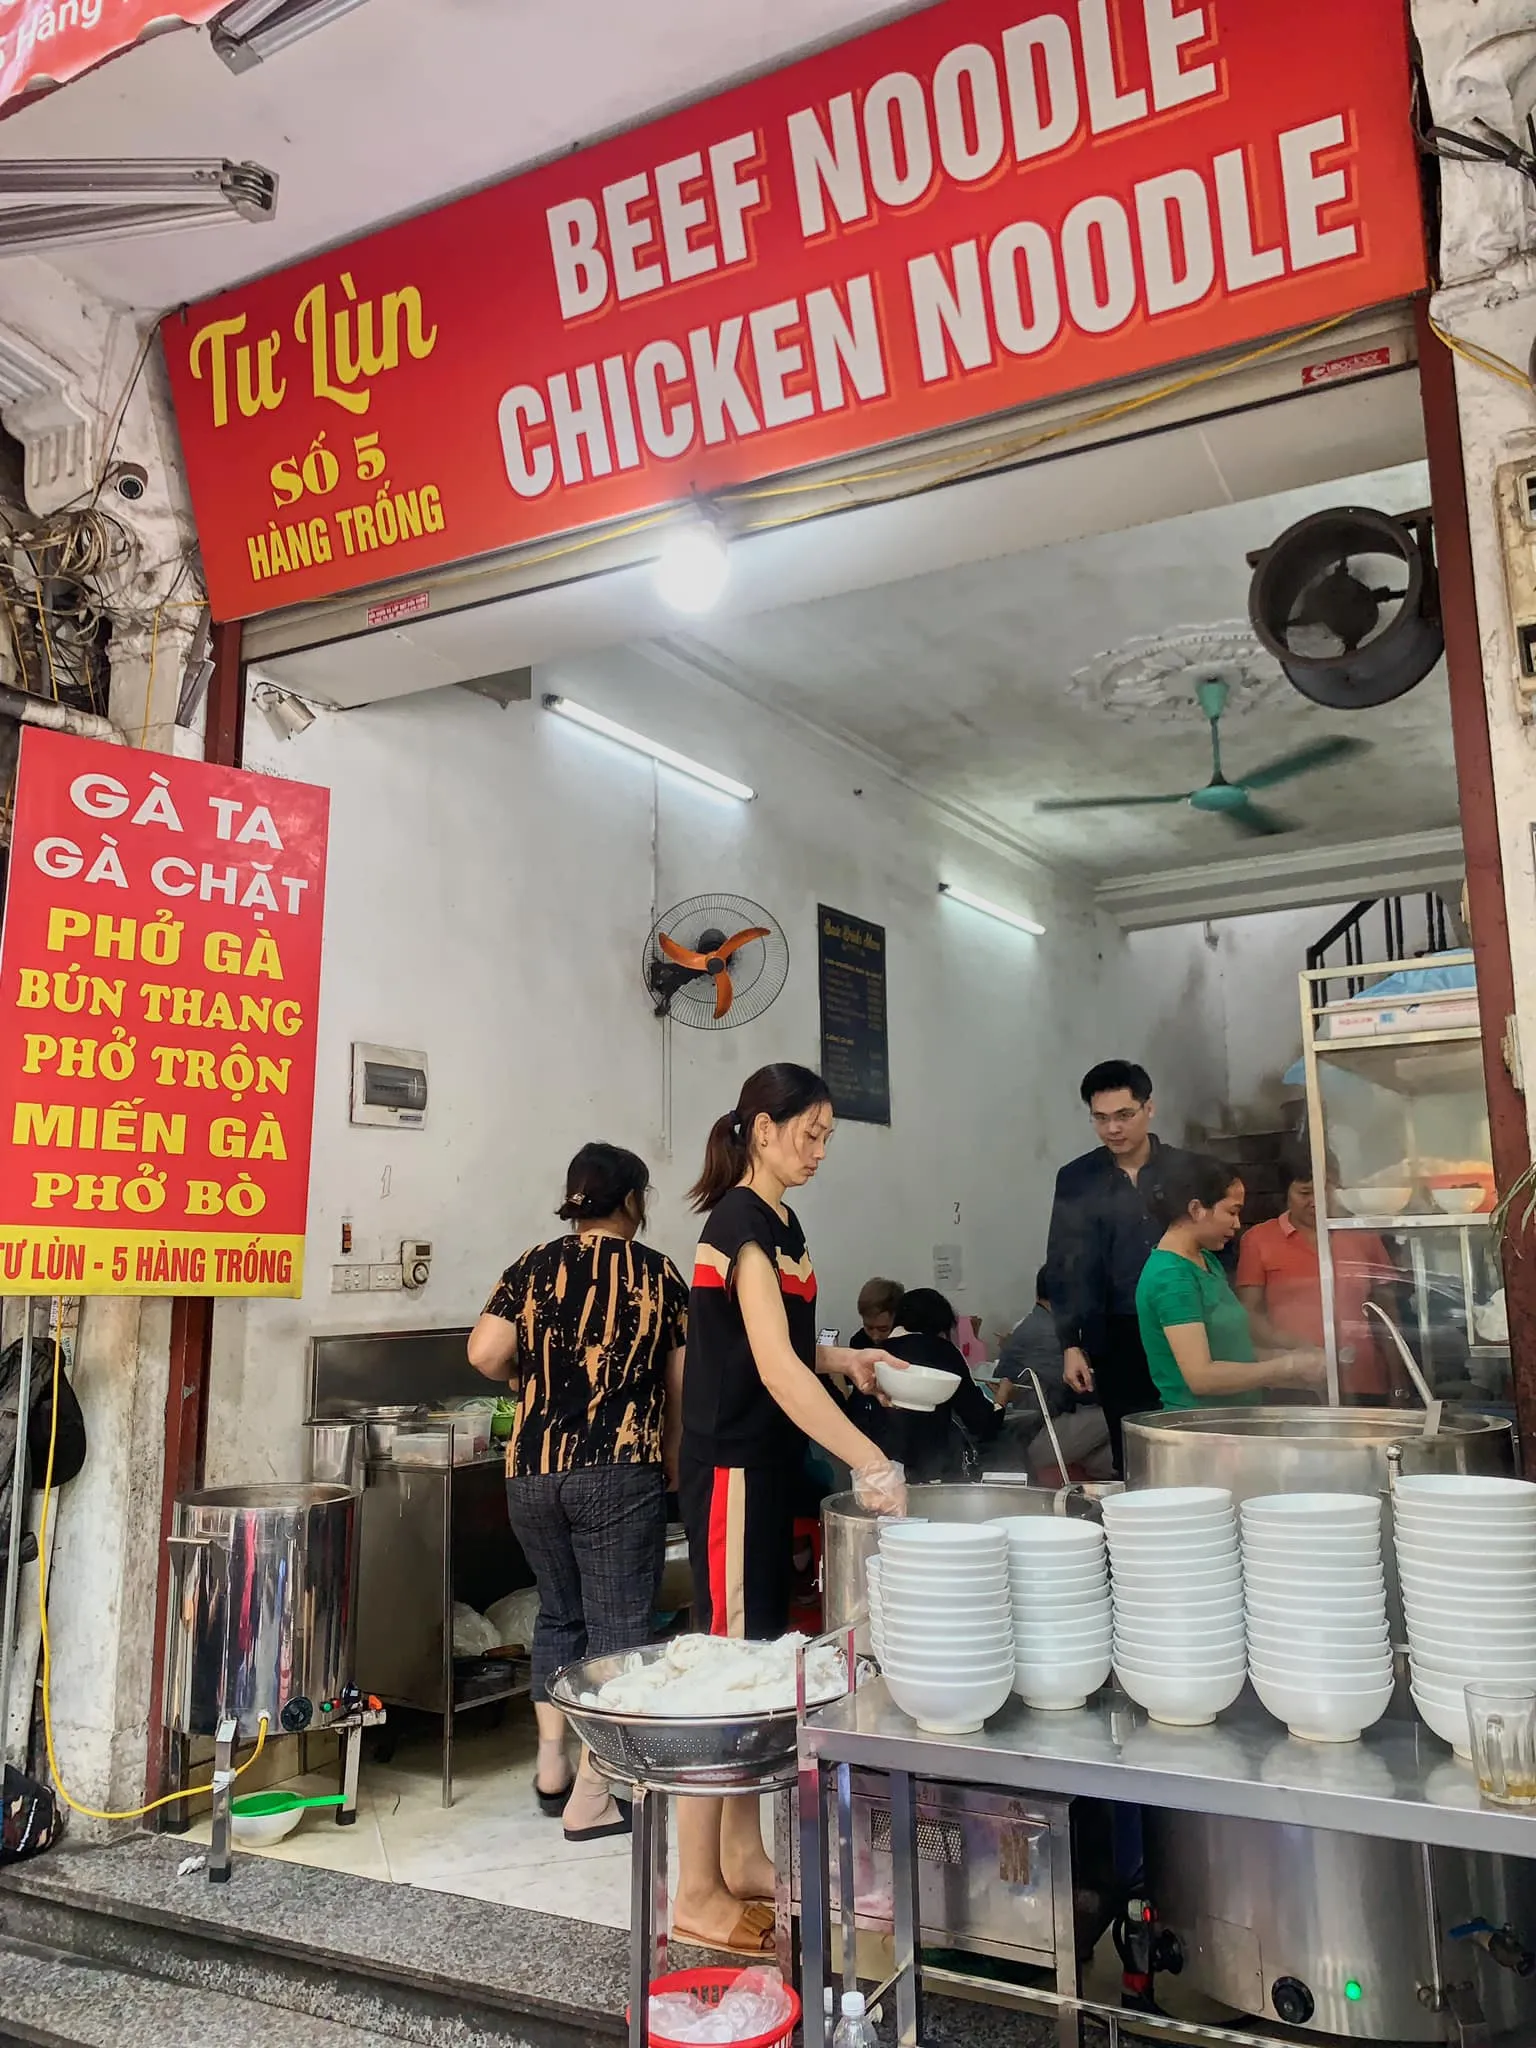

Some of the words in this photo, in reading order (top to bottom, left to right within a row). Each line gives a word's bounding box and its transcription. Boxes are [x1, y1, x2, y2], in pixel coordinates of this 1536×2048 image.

[547, 132, 760, 319] BEEF
[788, 0, 1217, 237] NOODLE
[499, 275, 886, 497] CHICKEN
[908, 115, 1357, 382] NOODLE
[189, 312, 286, 427] Tư
[294, 272, 438, 414] Lùn
[353, 431, 386, 481] 5
[247, 520, 333, 581] HÀNG
[335, 479, 446, 556] TRỐNG
[69, 771, 184, 833] GÀ
[208, 796, 284, 850] TA
[33, 832, 130, 889] GÀ
[150, 862, 309, 921] CHẶT
[46, 906, 185, 966] PHỞ
[203, 928, 284, 981] GÀ
[15, 963, 128, 1018] BÚN
[139, 983, 304, 1037] THANG
[21, 1025, 137, 1081] PHỞ
[150, 1042, 293, 1102] TRỘN
[11, 1097, 187, 1155] MIẾN
[208, 1111, 288, 1161] GÀ
[31, 1162, 168, 1213] PHỞ
[183, 1172, 267, 1217] BÒ
[30, 1235, 86, 1281] LÙN
[93, 1262, 104, 1270] -
[111, 1246, 128, 1282] 5
[135, 1239, 206, 1283] HÀNG
[214, 1236, 293, 1284] TRỐNG
